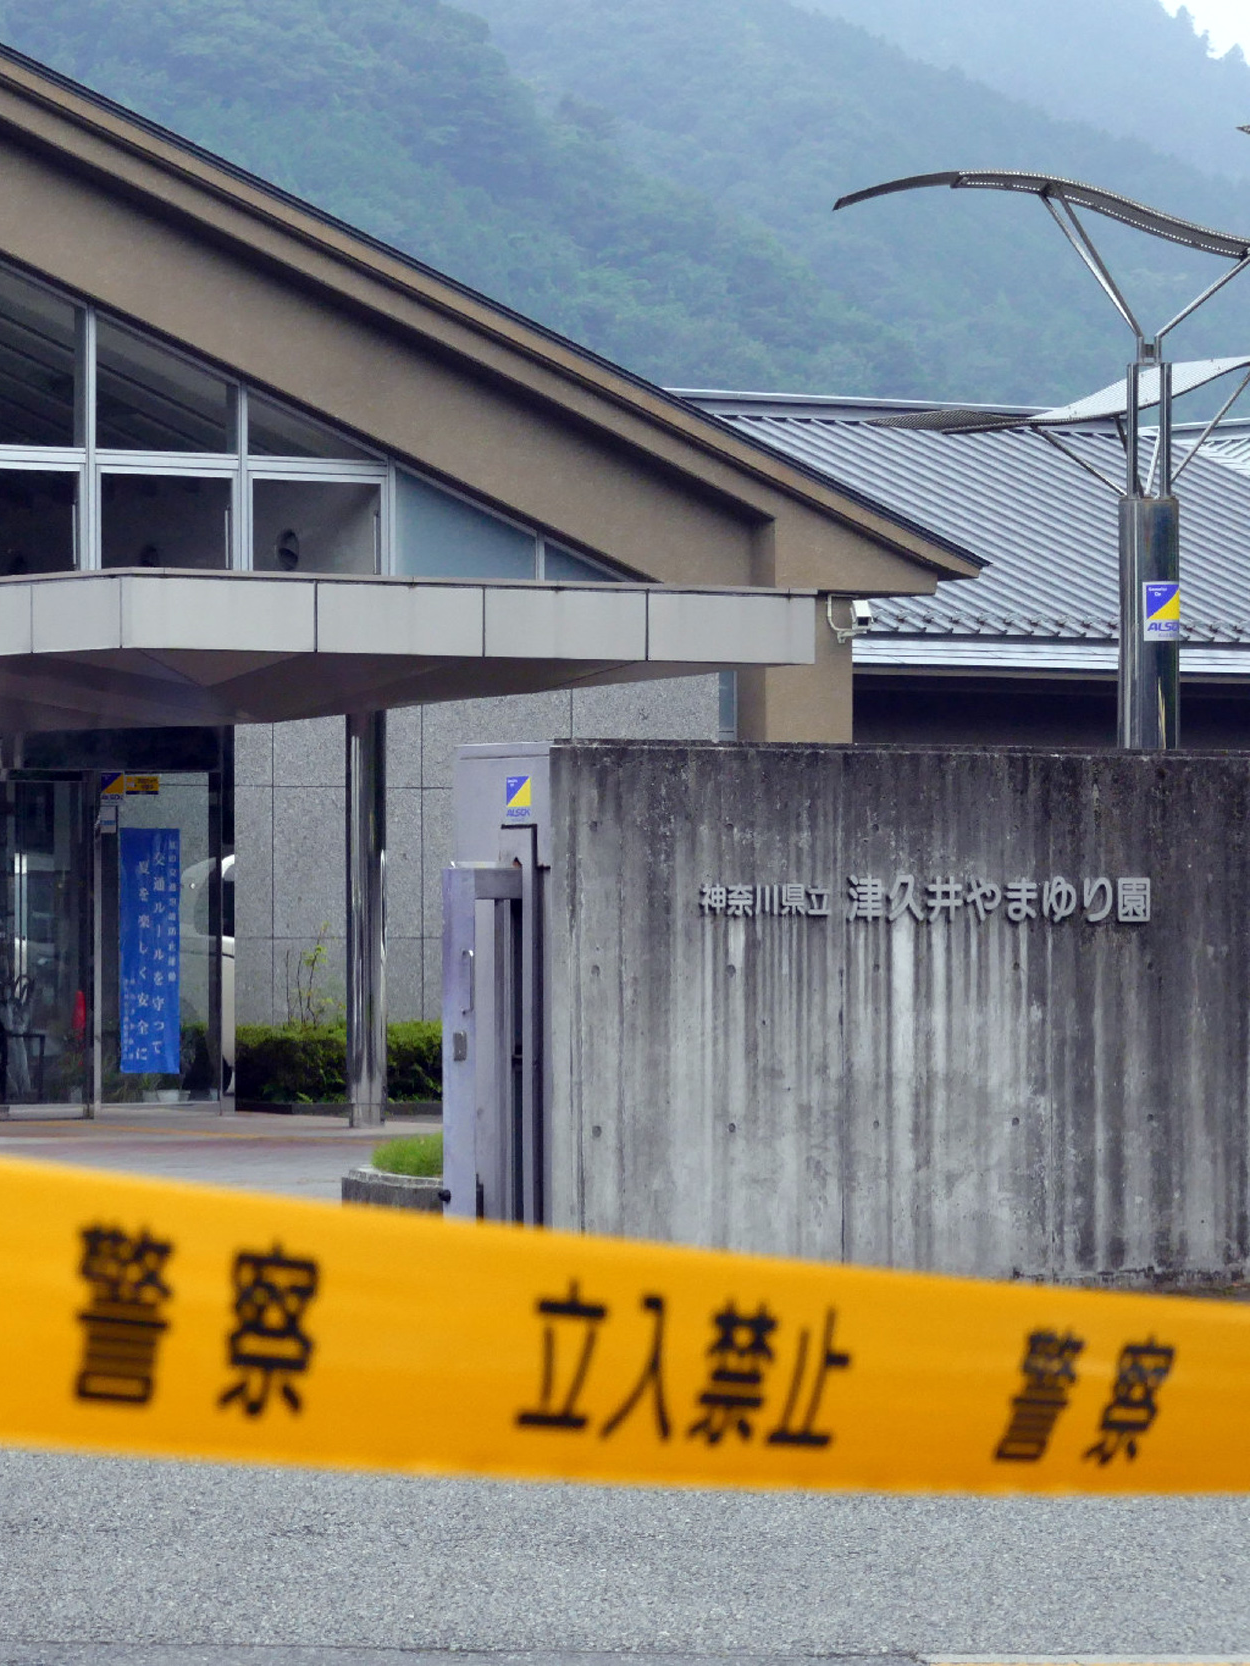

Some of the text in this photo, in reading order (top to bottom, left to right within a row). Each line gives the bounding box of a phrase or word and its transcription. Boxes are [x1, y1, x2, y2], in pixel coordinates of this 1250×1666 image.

[152, 851, 165, 1054] 交通ルールを守って
[701, 873, 1152, 924] 神奈川県立 津久井やまゆり園
[72, 1222, 322, 1419] 警察
[515, 1277, 852, 1450] 立入禁止
[992, 1327, 1177, 1467] 警察
